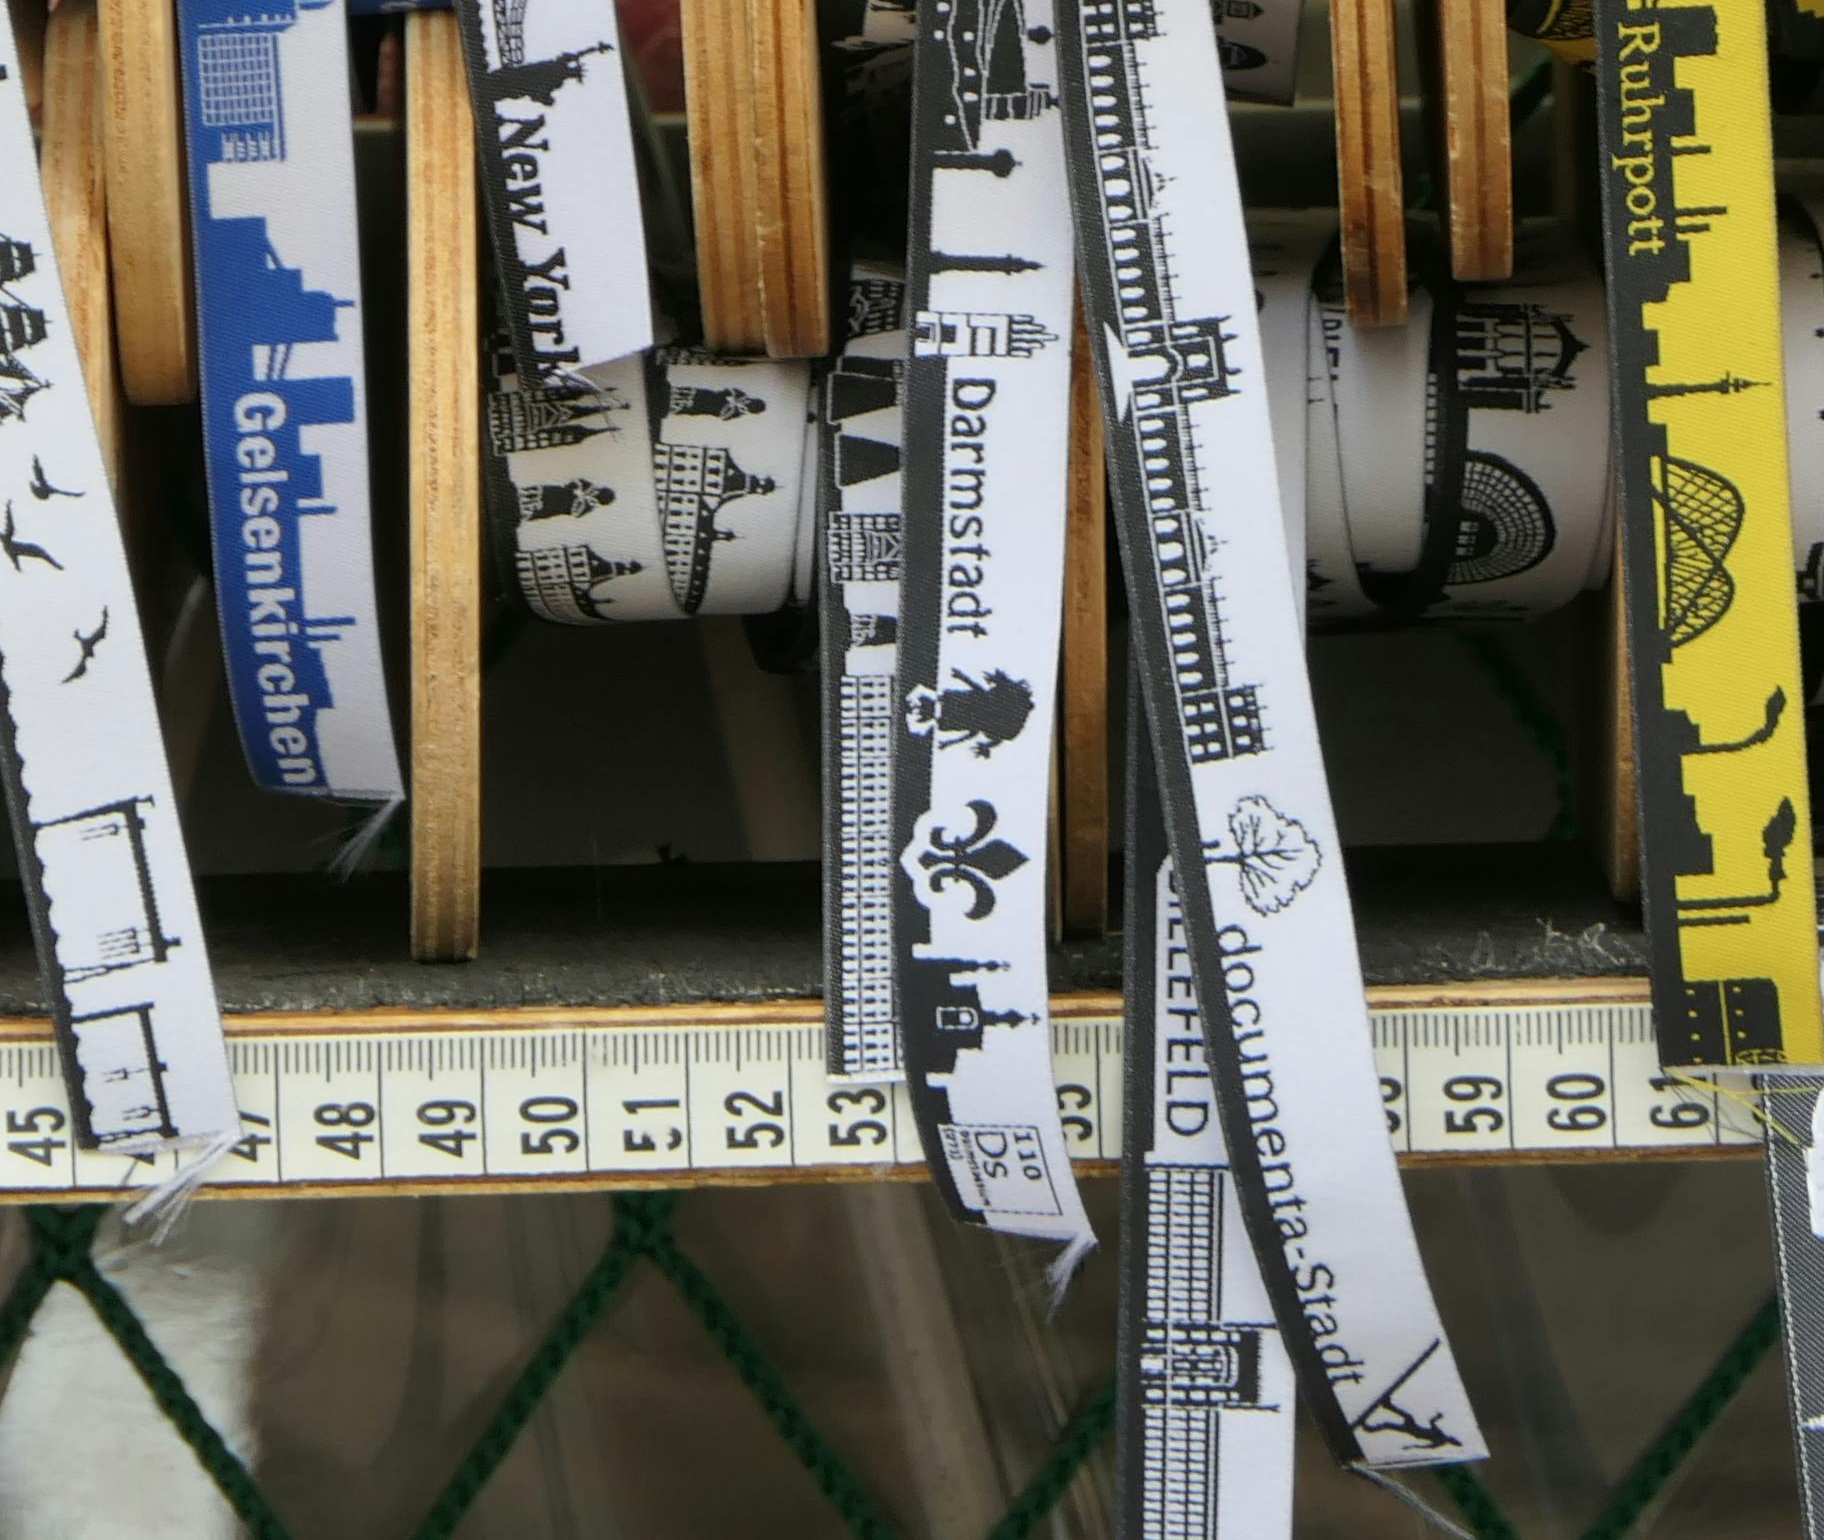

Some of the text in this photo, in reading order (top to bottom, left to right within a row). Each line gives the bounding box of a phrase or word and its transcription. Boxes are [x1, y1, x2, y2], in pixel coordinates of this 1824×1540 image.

[1614, 20, 1665, 257] Ruhrpott
[496, 110, 551, 237] New
[947, 376, 998, 639] Darmstadt
[233, 391, 316, 787] Gelsenkirchen
[418, 1102, 475, 1157] 49
[521, 1098, 578, 1153] 50
[725, 1092, 783, 1148] 52
[828, 1090, 888, 1146] 53
[1444, 1077, 1503, 1132] 59
[1547, 1075, 1606, 1130] 60
[1649, 1077, 1709, 1127] 61
[7, 1107, 66, 1166] 45
[315, 1104, 374, 1159] 48
[1013, 1131, 1043, 1181] 110
[1216, 923, 1366, 1386] documenta-Stadt
